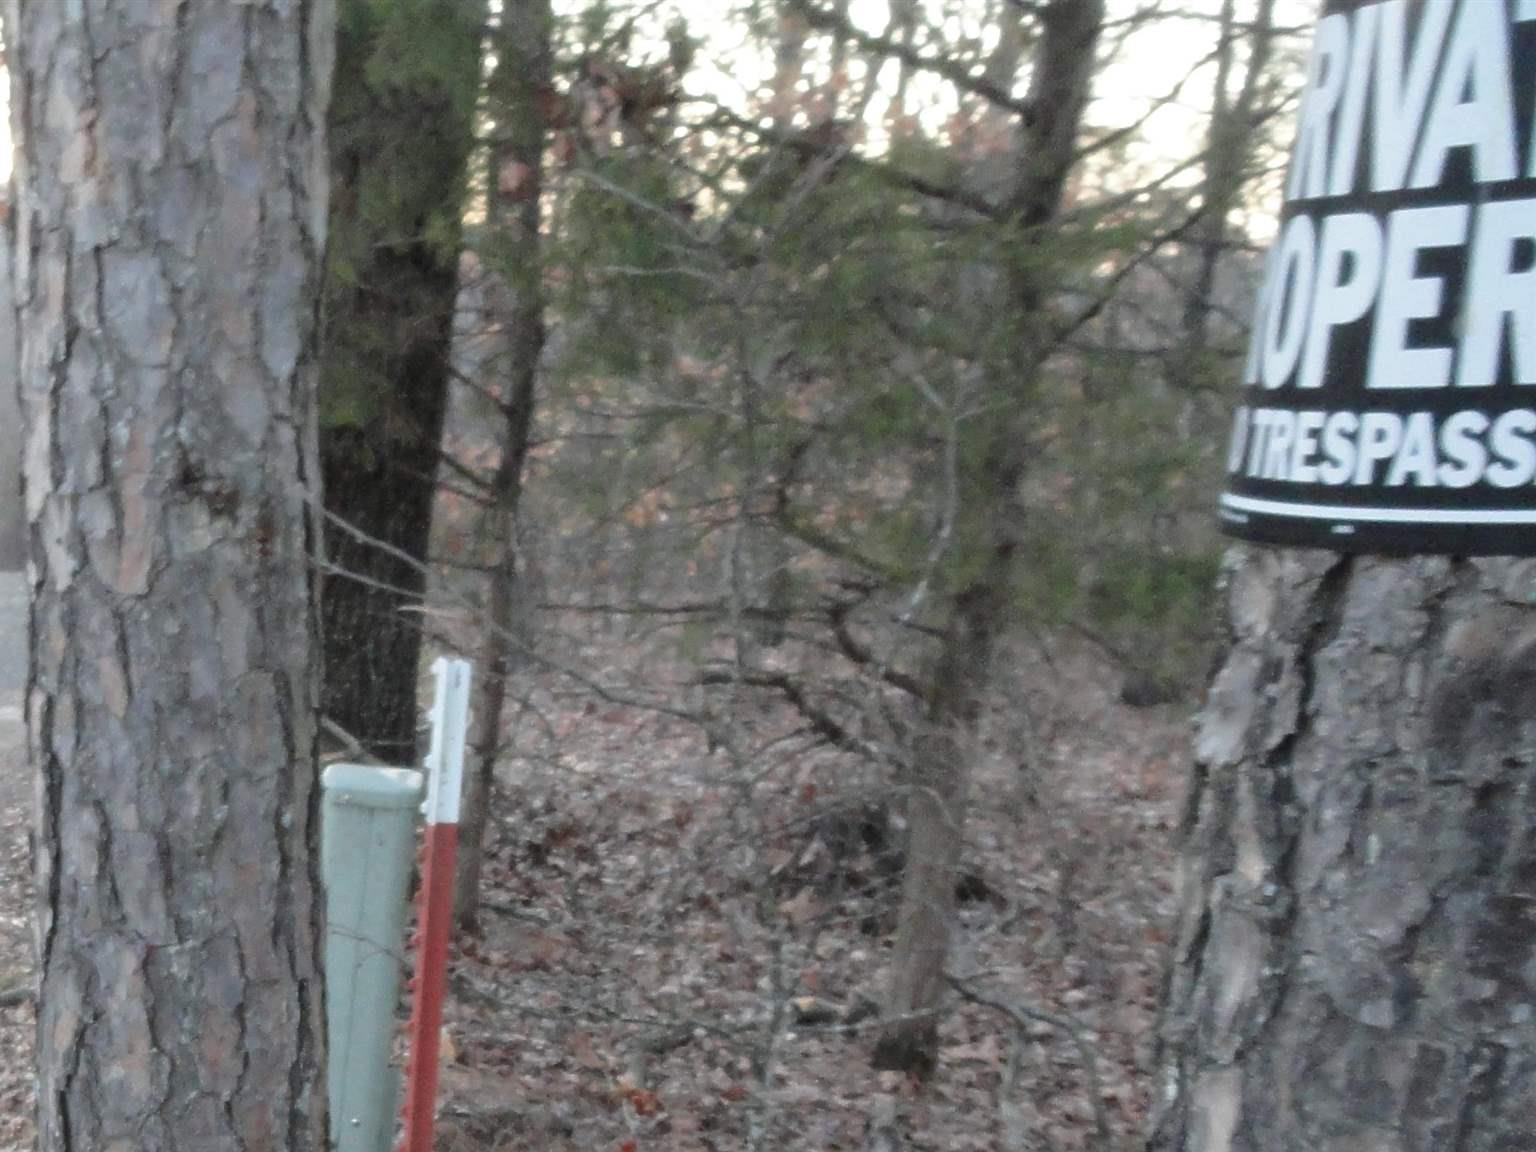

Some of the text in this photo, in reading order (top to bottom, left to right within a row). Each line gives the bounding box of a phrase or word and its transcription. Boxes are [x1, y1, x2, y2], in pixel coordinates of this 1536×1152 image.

[1287, 0, 1536, 200] RIVA
[1245, 199, 1536, 389] OPER
[1246, 407, 1536, 488] TRESPASS
